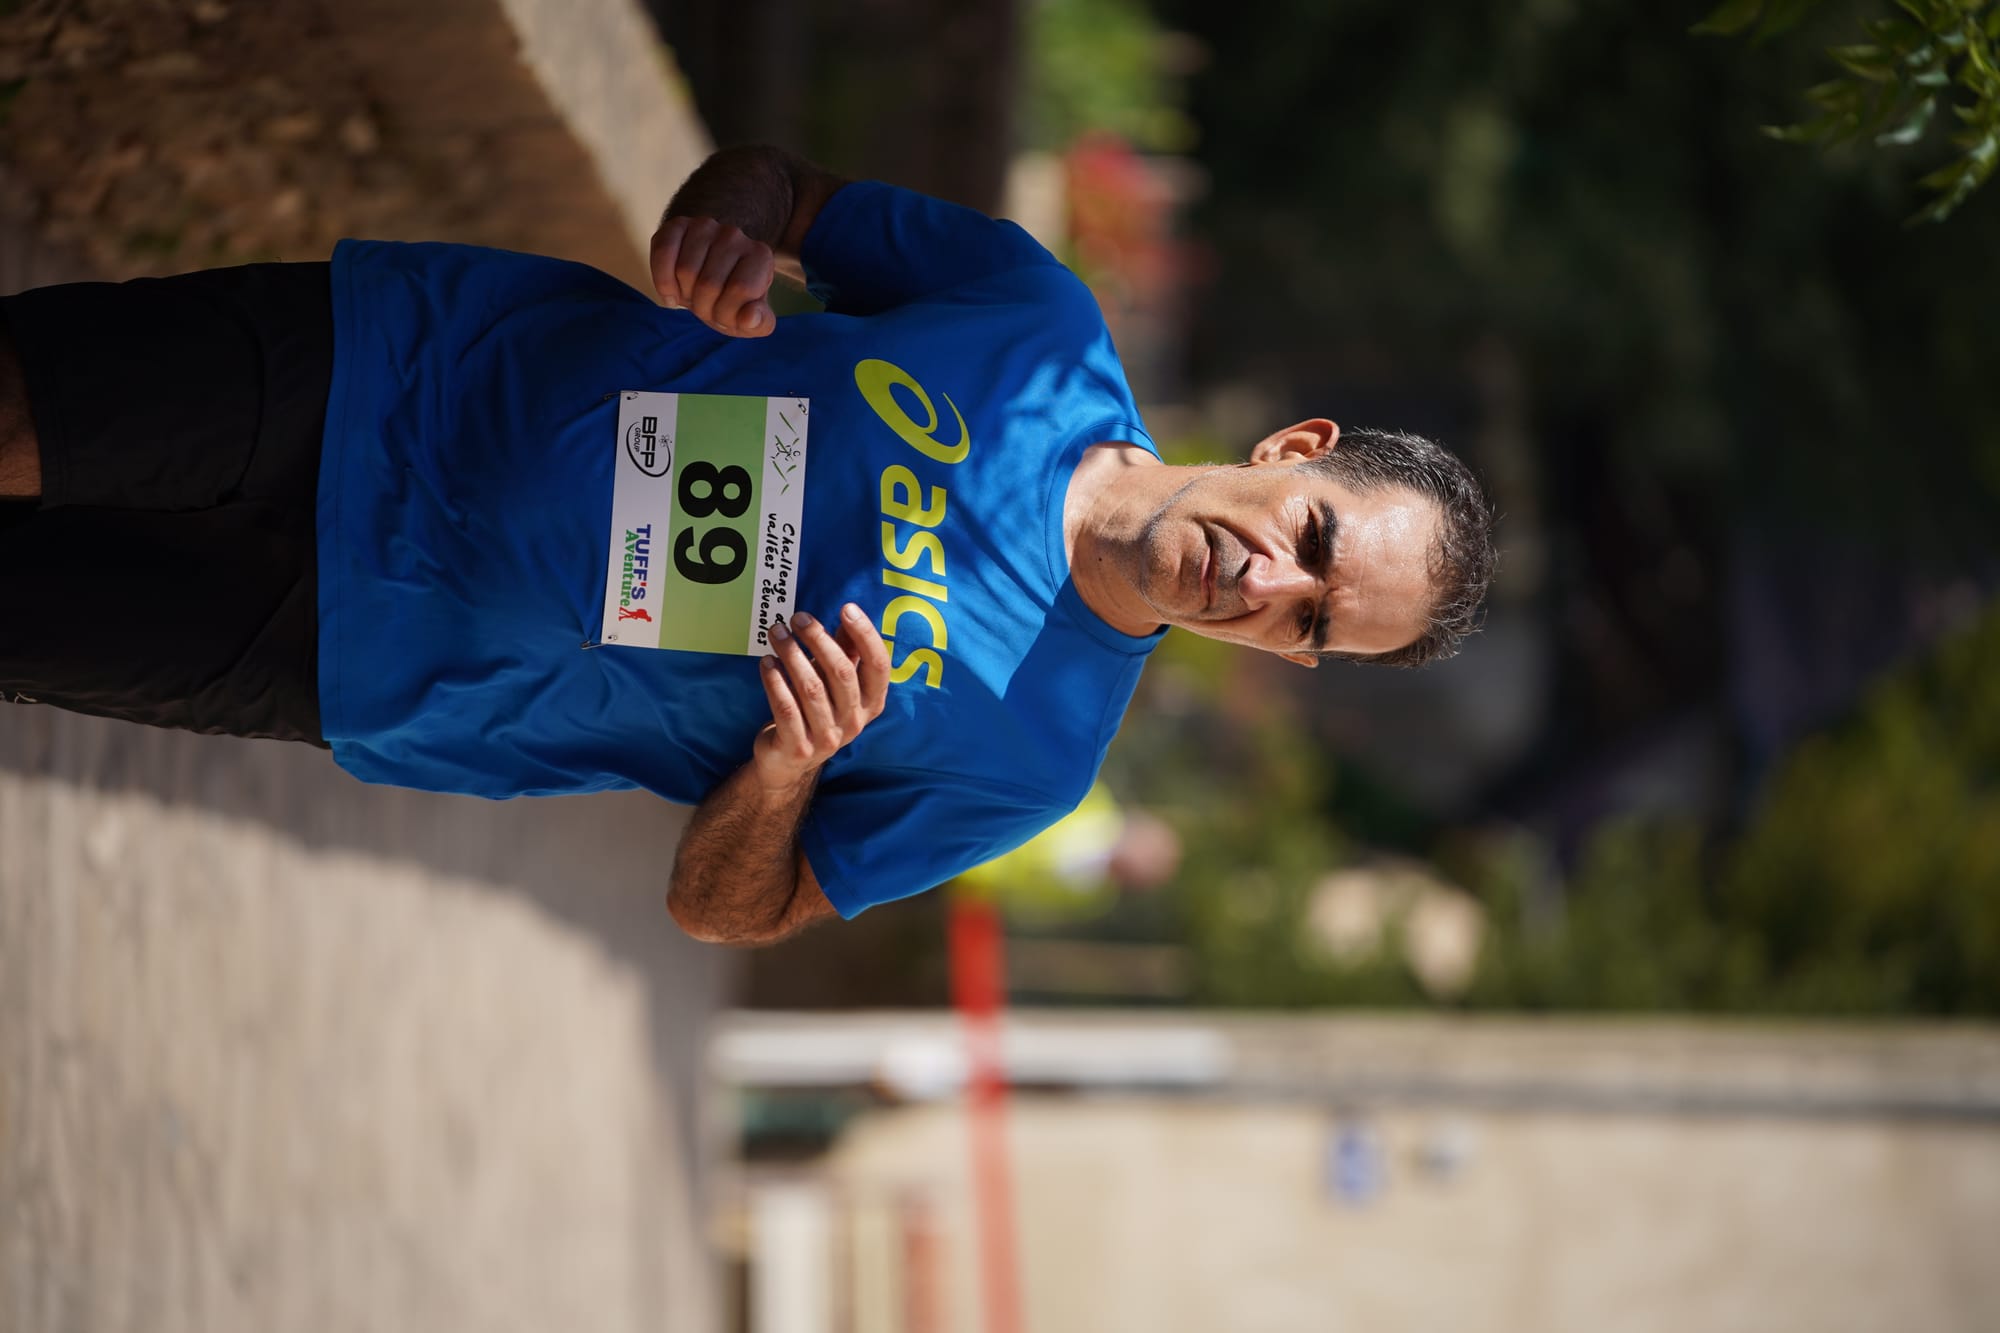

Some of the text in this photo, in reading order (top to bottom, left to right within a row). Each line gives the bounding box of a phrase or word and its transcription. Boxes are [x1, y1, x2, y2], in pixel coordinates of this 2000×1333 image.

[640, 416, 657, 468] BFP
[631, 524, 651, 600] TUFF'S
[674, 461, 752, 584] 89
[620, 529, 640, 607] Aventure
[757, 513, 779, 646] vallées cévenoles
[774, 523, 795, 603] Challenge
[880, 464, 948, 689] asics
